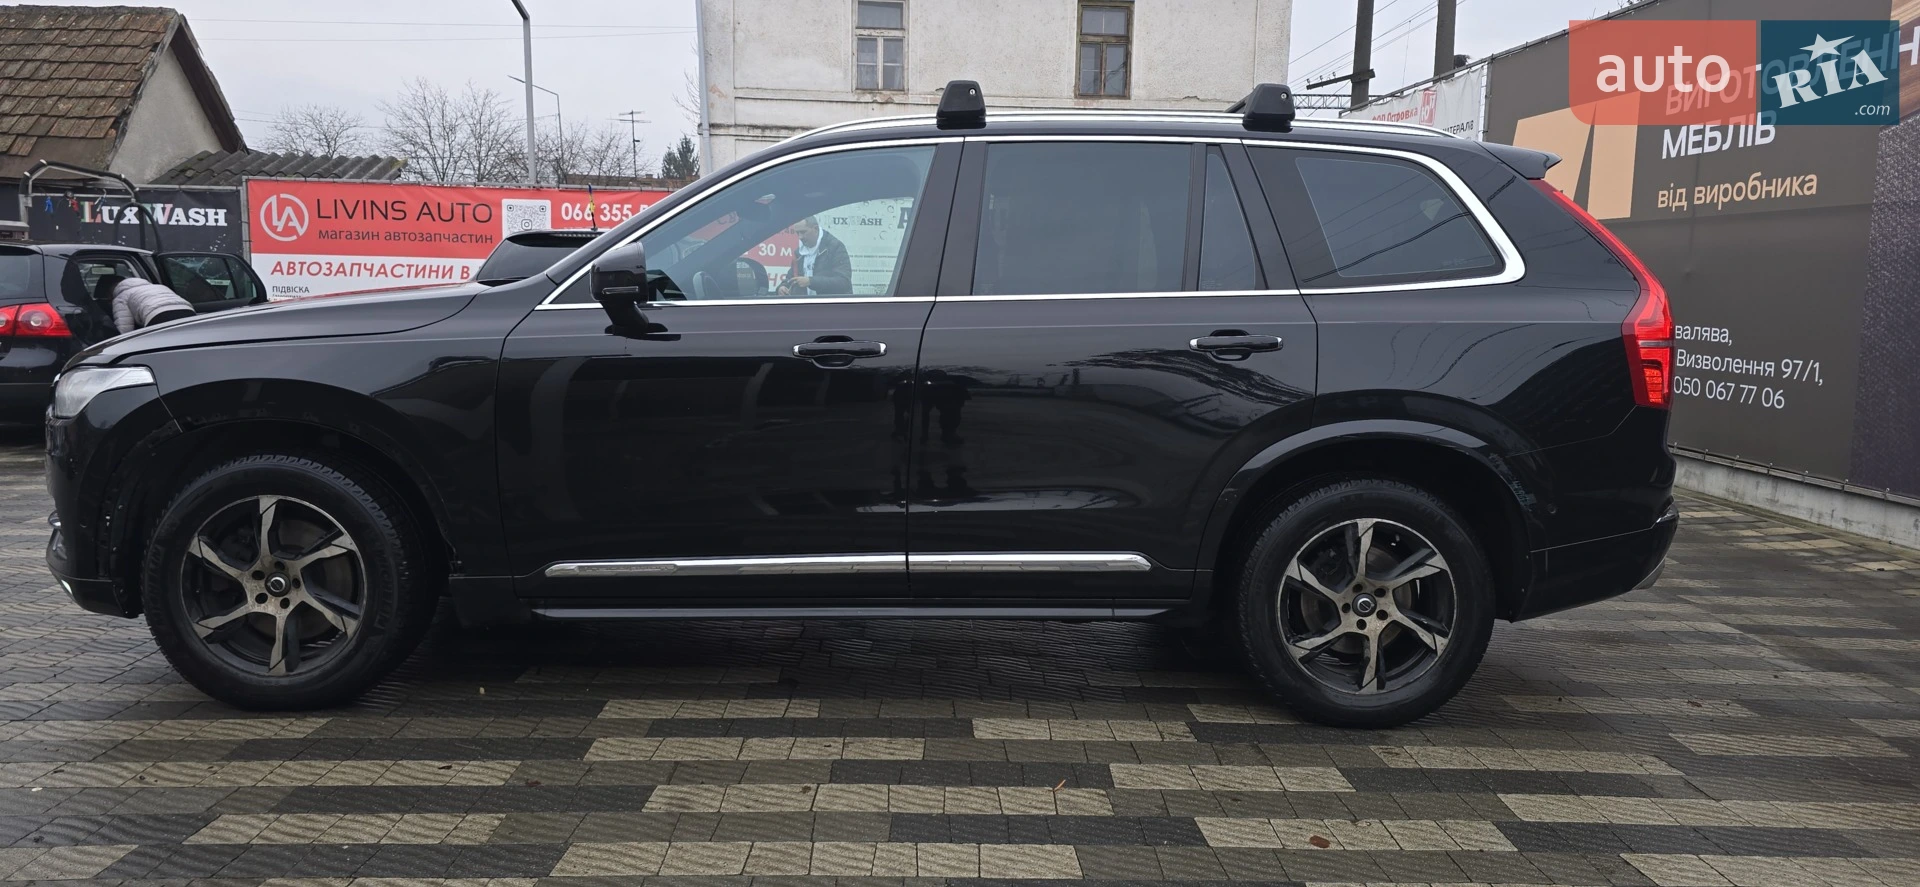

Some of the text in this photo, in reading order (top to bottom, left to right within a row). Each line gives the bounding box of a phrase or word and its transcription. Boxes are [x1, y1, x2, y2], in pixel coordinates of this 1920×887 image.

[1662, 110, 1777, 160] МЕБЛІВ
[1657, 172, 1819, 212] від виробника
[317, 199, 492, 223] LIVINS AUTO
[561, 202, 594, 221] 066
[600, 203, 633, 222] 355
[318, 230, 493, 245] магазин автозапчастин
[758, 243, 776, 257] 30
[271, 260, 453, 280] АВТОЗАПЧАСТИНИ
[272, 286, 310, 294] ПІДВІСКА
[1676, 348, 1824, 386] Визволення 97/1,
[1674, 375, 1785, 409] 050 067 77 06
